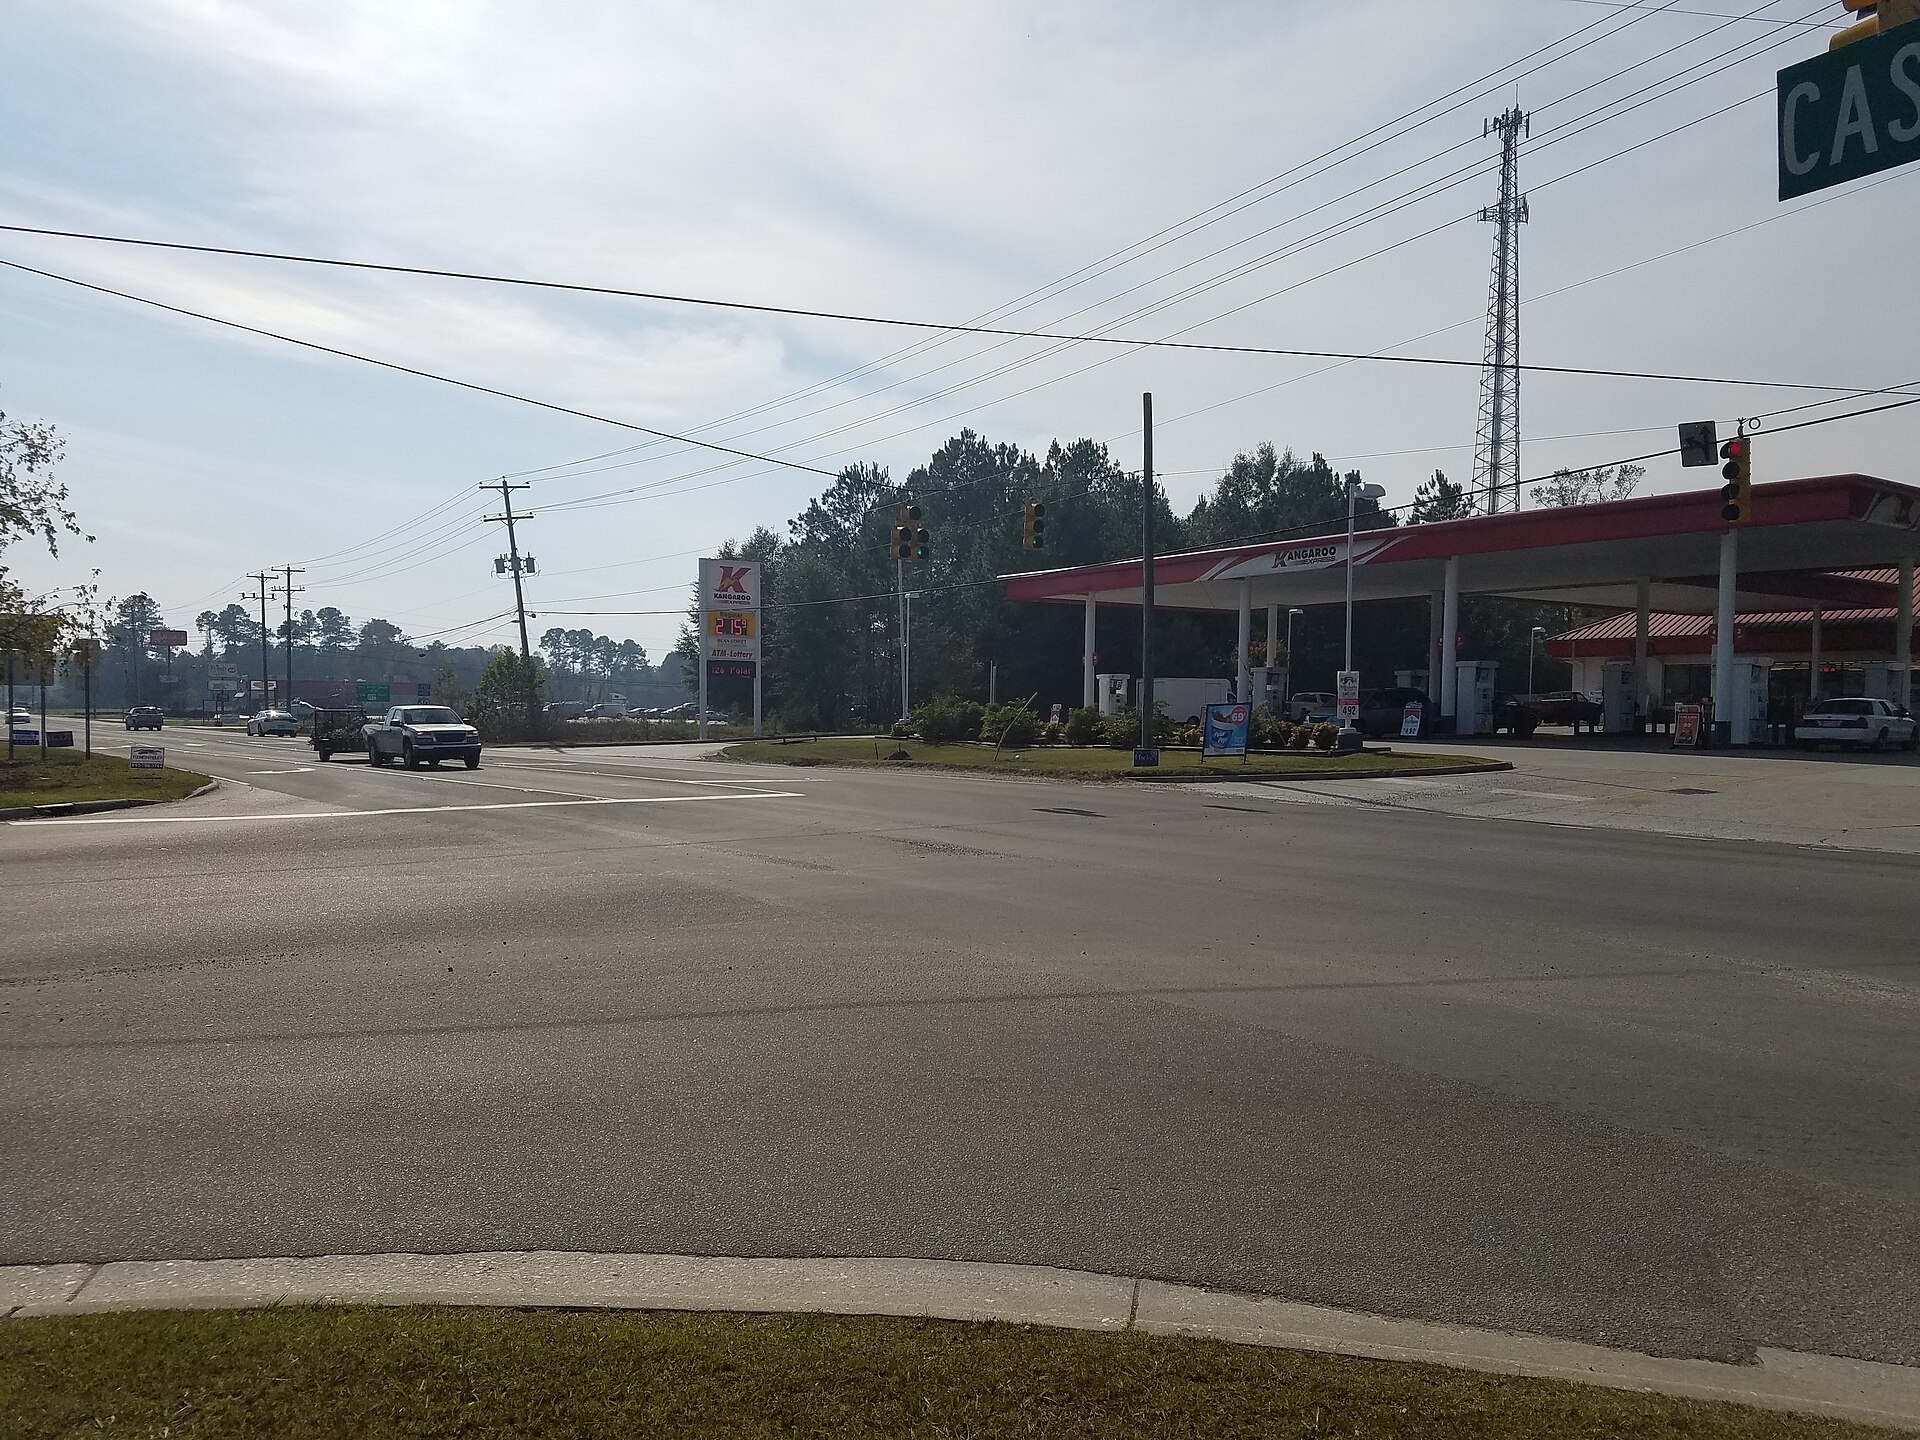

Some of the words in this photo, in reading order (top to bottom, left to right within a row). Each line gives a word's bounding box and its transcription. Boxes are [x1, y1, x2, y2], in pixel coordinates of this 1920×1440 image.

[1783, 42, 1920, 176] CAS
[1272, 546, 1337, 568] KANGAROO
[1304, 556, 1337, 565] EXPRESS
[716, 566, 751, 593] K
[713, 593, 751, 601] KANGAROO
[711, 649, 726, 657] ATM
[730, 650, 753, 660] Lottery
